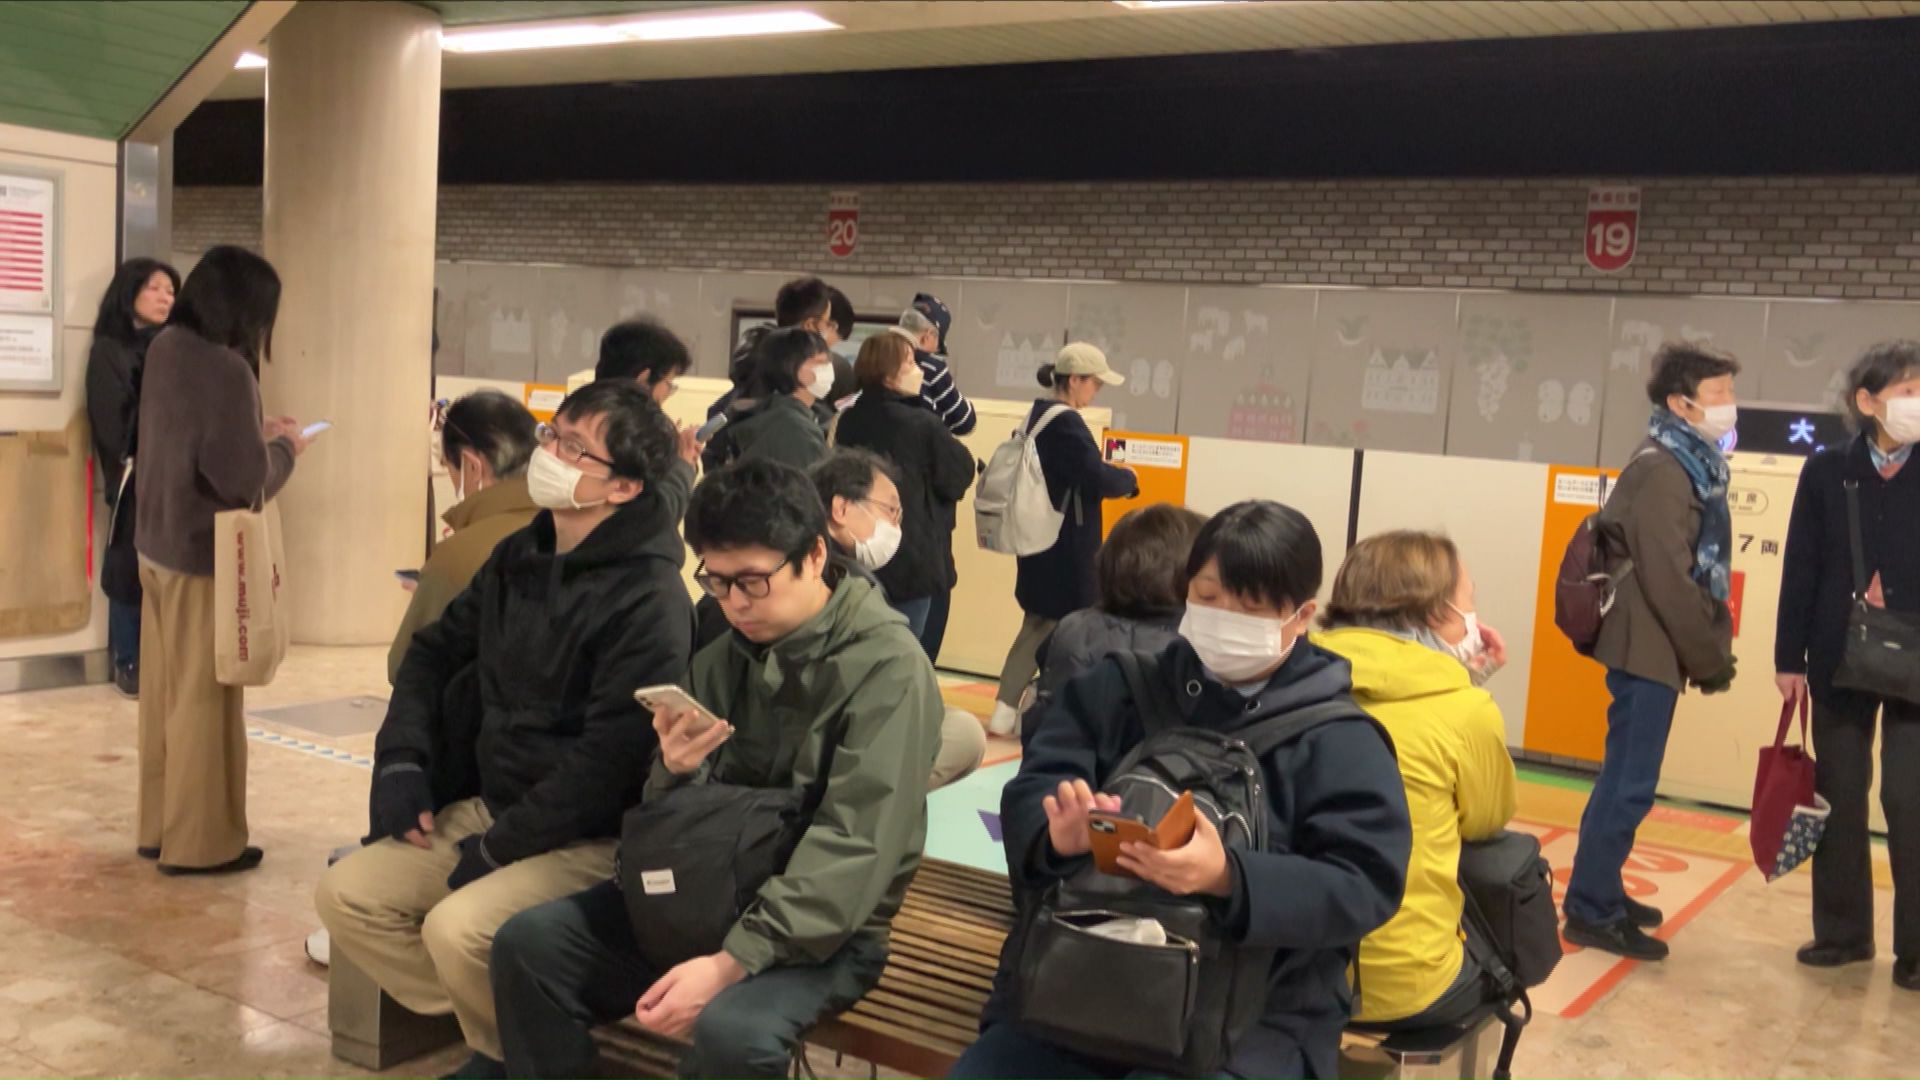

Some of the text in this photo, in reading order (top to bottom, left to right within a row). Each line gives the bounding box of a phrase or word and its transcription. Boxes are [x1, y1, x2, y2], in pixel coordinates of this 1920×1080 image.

[830, 219, 857, 246] 20
[1591, 222, 1630, 256] 19
[1788, 418, 1815, 443] 大
[236, 531, 250, 662] www.muji.com
